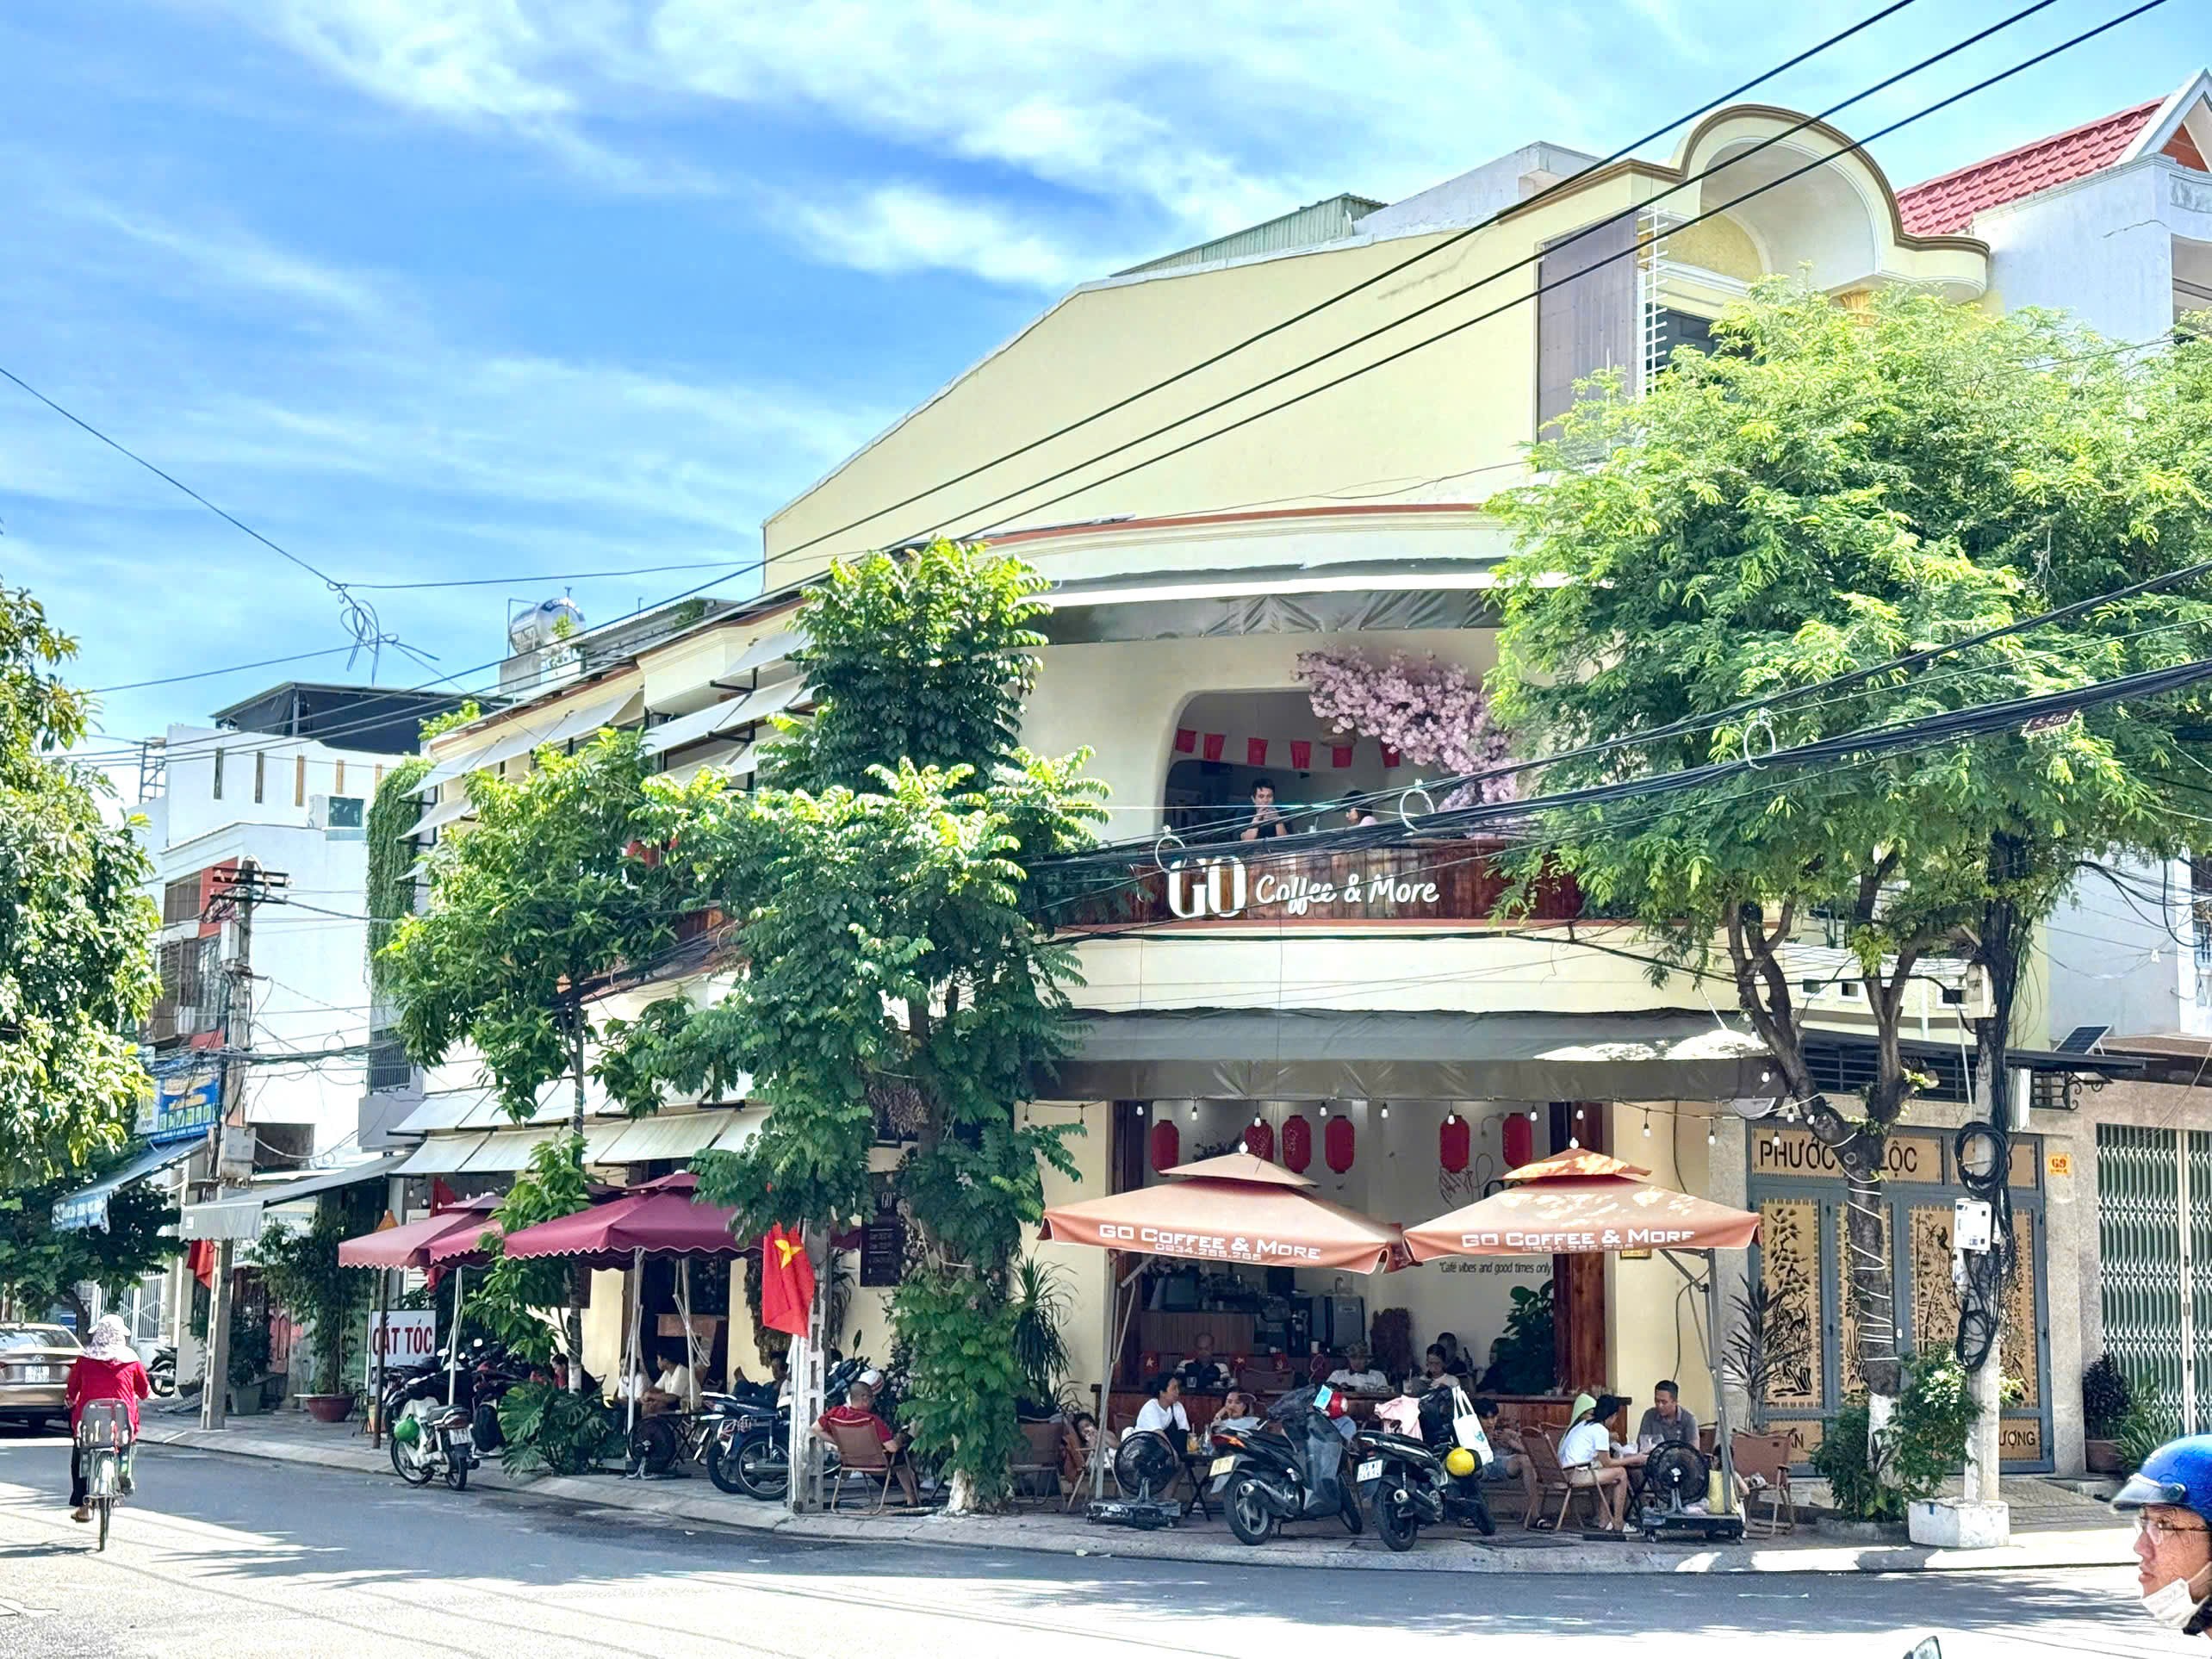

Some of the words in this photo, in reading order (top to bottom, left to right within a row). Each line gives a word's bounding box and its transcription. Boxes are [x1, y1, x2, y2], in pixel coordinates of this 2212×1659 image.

[1168, 855, 1246, 918] GO
[1255, 874, 1337, 916] Coffee
[1344, 873, 1363, 904] &
[1369, 873, 1440, 904] More
[1099, 1224, 1134, 1240] GO
[1140, 1227, 1226, 1250] COFFEE
[1231, 1237, 1250, 1252] &
[1256, 1239, 1320, 1260] MORE
[1461, 1233, 1499, 1248] GO
[1506, 1231, 1594, 1246] COFFEE
[1600, 1228, 1621, 1245] &
[1479, 1262, 1493, 1273] and
[1494, 1262, 1513, 1276] good
[1515, 1261, 1533, 1273] times
[405, 1318, 432, 1355] TÓC
